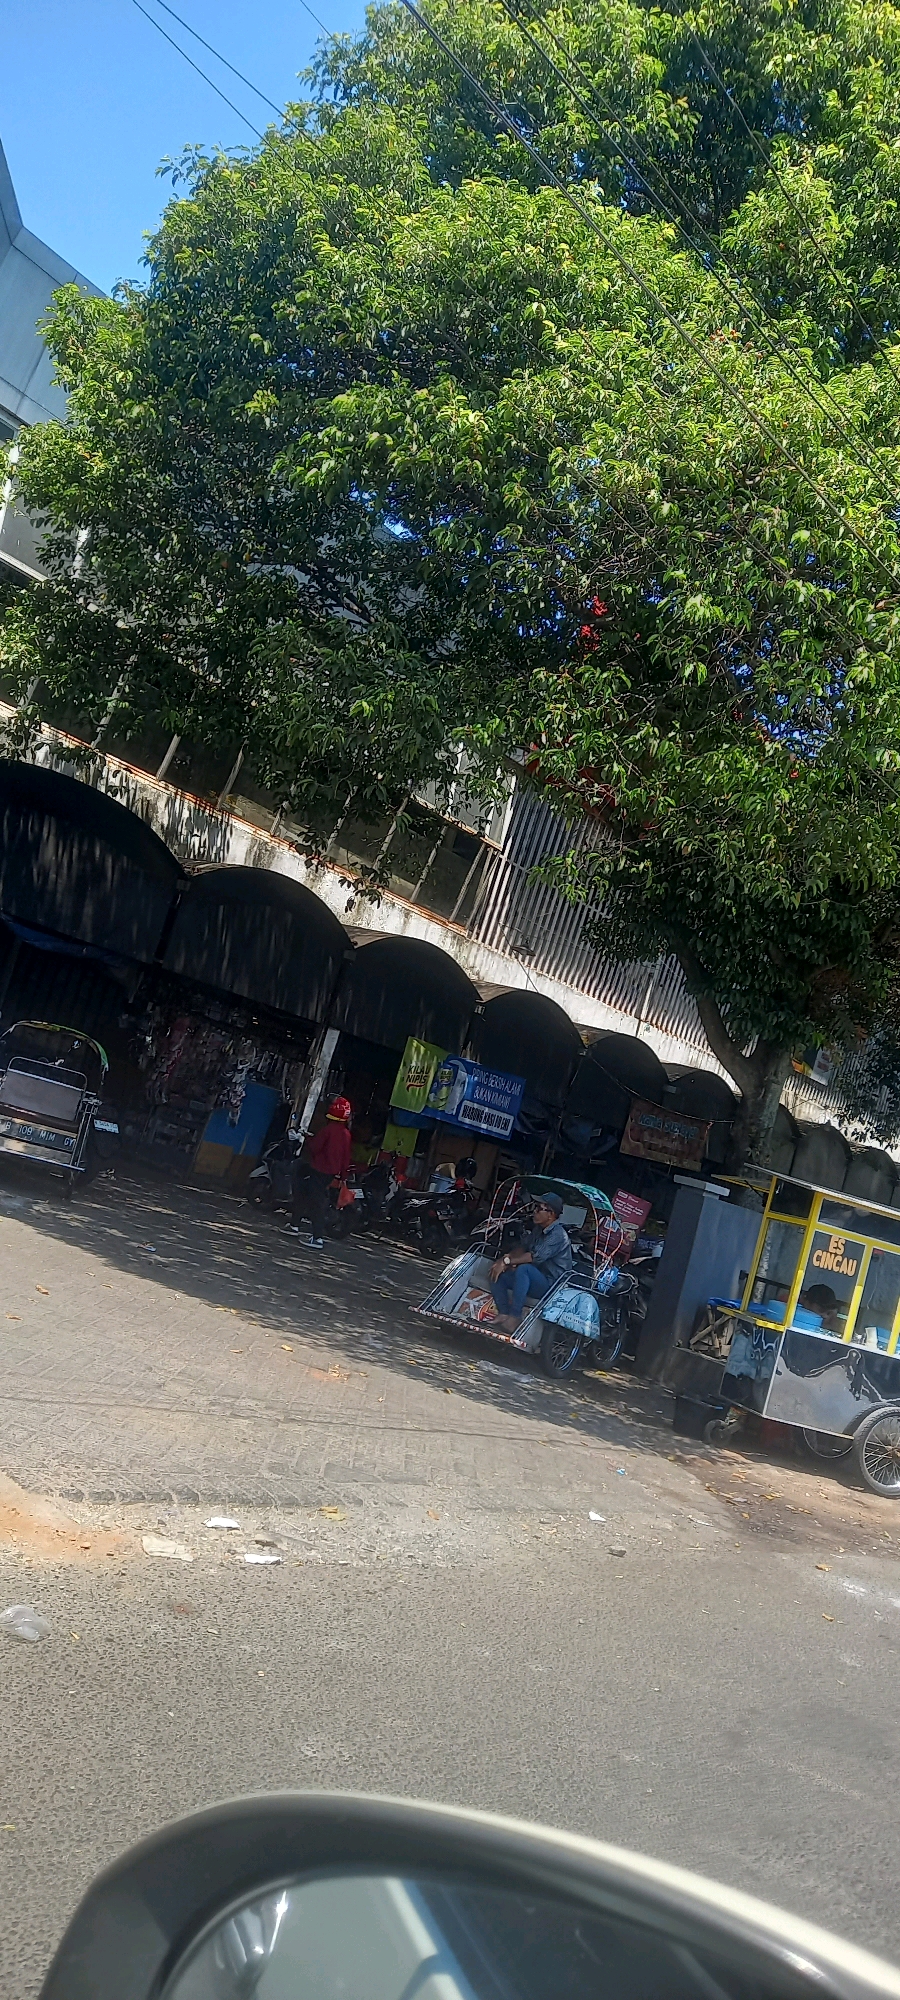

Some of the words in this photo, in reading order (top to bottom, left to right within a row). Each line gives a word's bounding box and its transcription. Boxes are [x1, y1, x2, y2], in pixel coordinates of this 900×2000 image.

[407, 1064, 431, 1075] KILAU
[406, 1074, 429, 1084] NIPIS
[39, 1130, 56, 1142] MIM
[829, 1235, 846, 1254] ES
[813, 1250, 857, 1276] CINCAU
